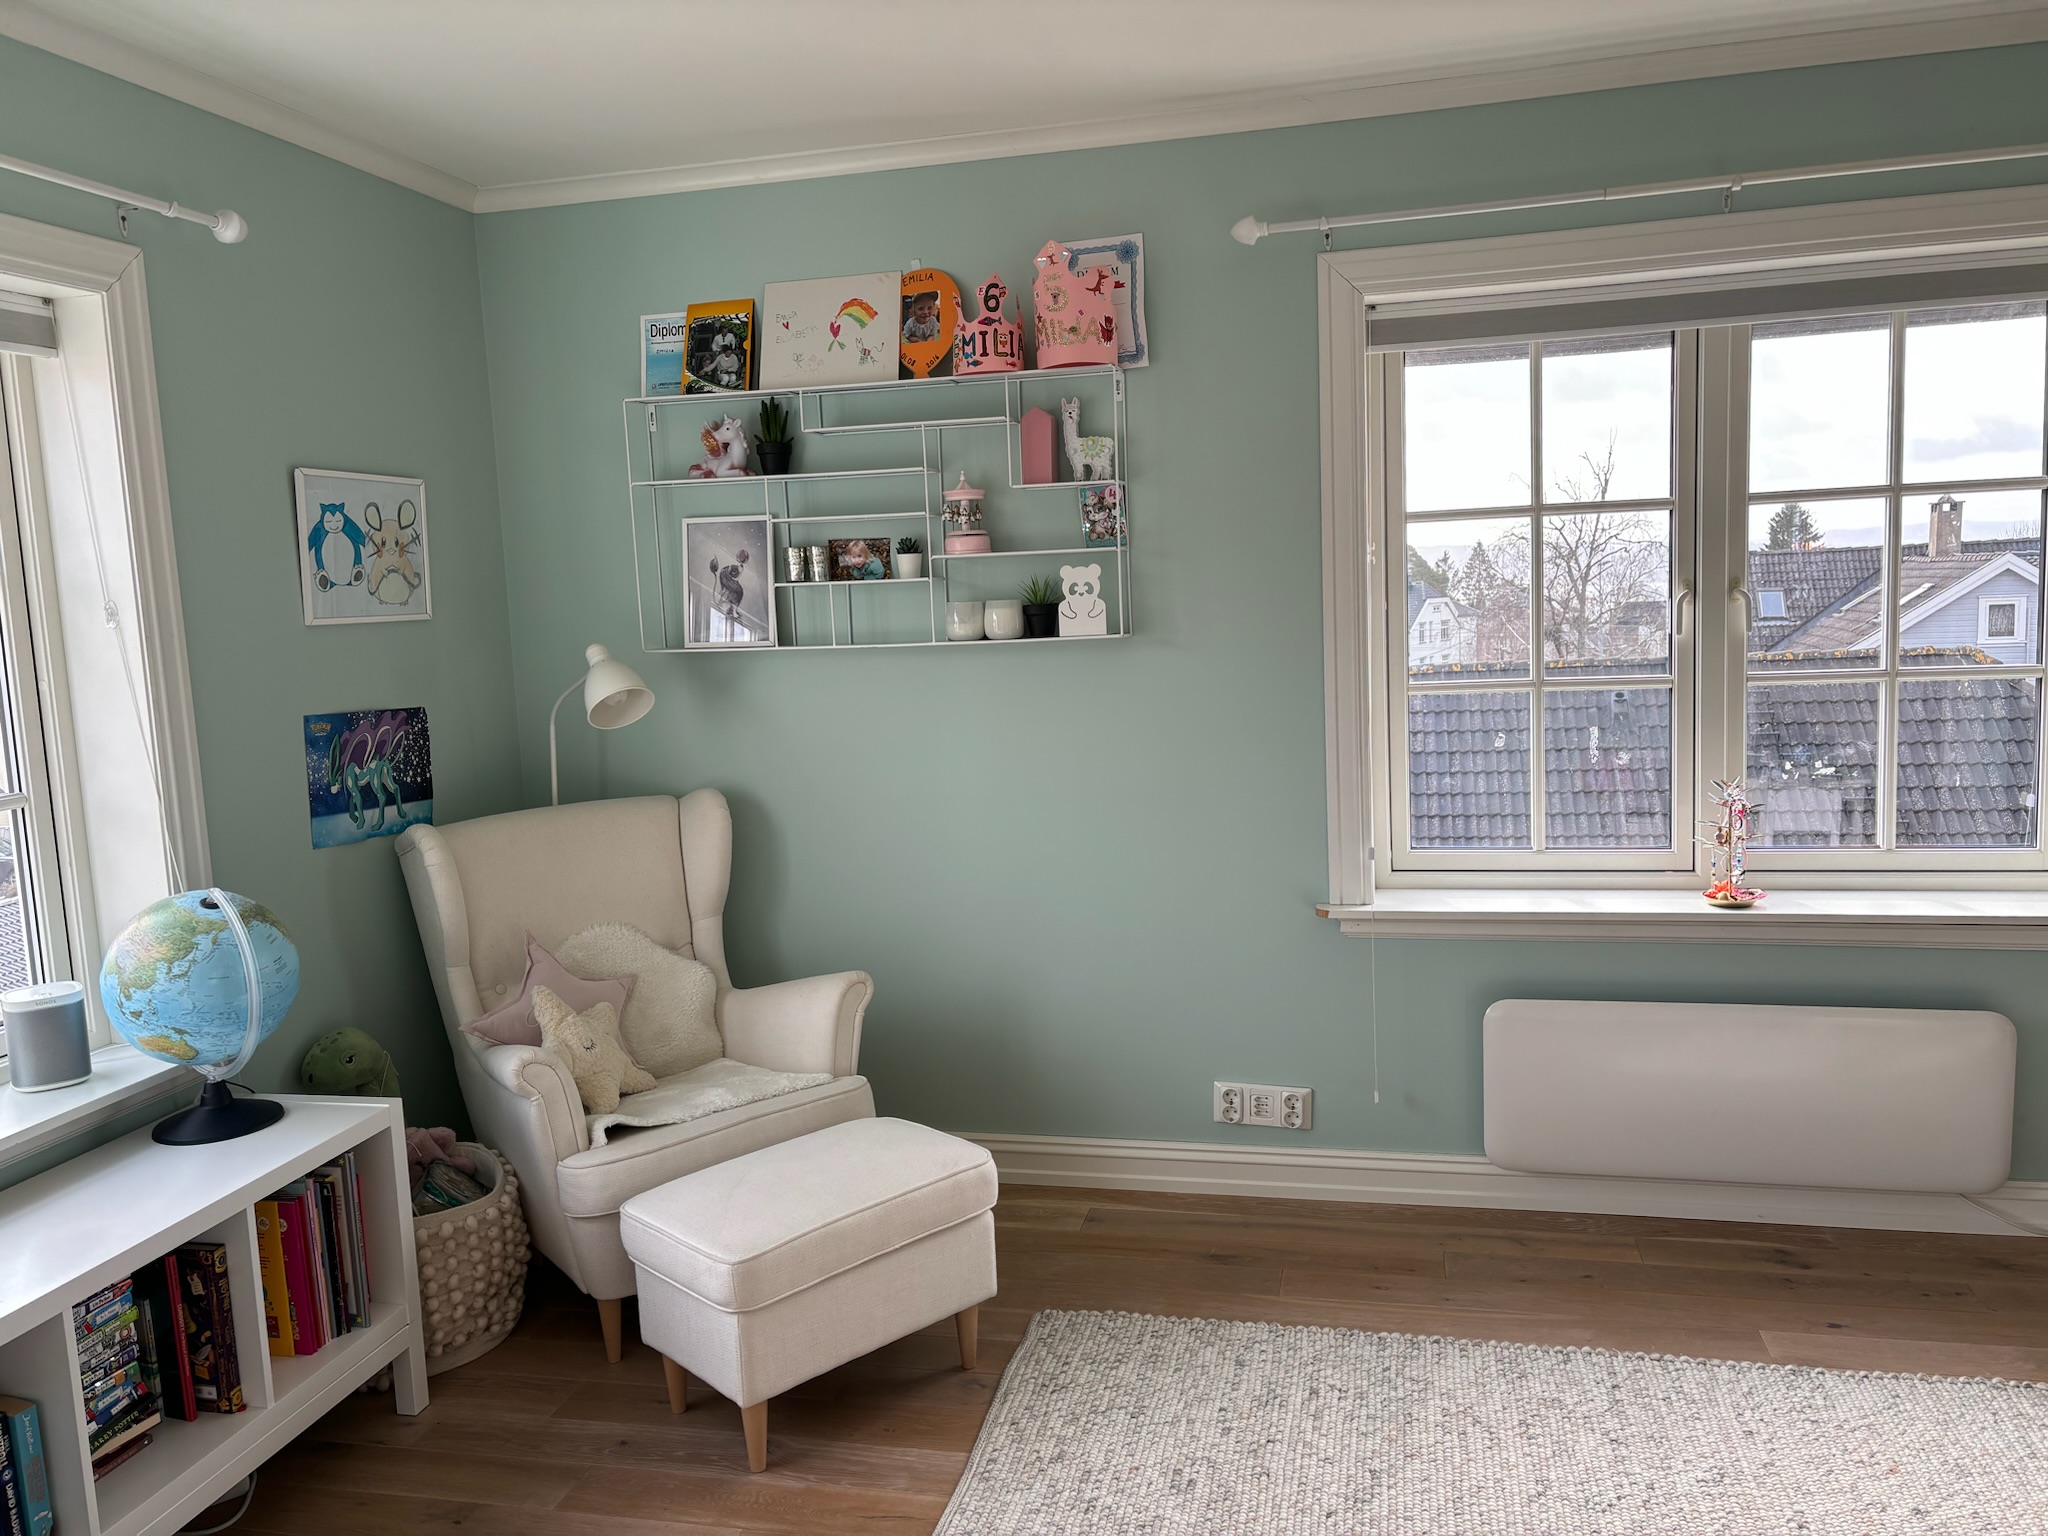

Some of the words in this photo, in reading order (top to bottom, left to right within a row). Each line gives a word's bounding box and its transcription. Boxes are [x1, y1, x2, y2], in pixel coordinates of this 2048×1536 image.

[902, 272, 934, 287] EMILIA
[1043, 271, 1069, 312] 5
[983, 282, 1000, 313] 6
[953, 327, 1024, 361] EMILIA
[925, 355, 940, 368] 2016
[114, 1411, 139, 1432] POTTER
[6, 1482, 16, 1508] DAVID
